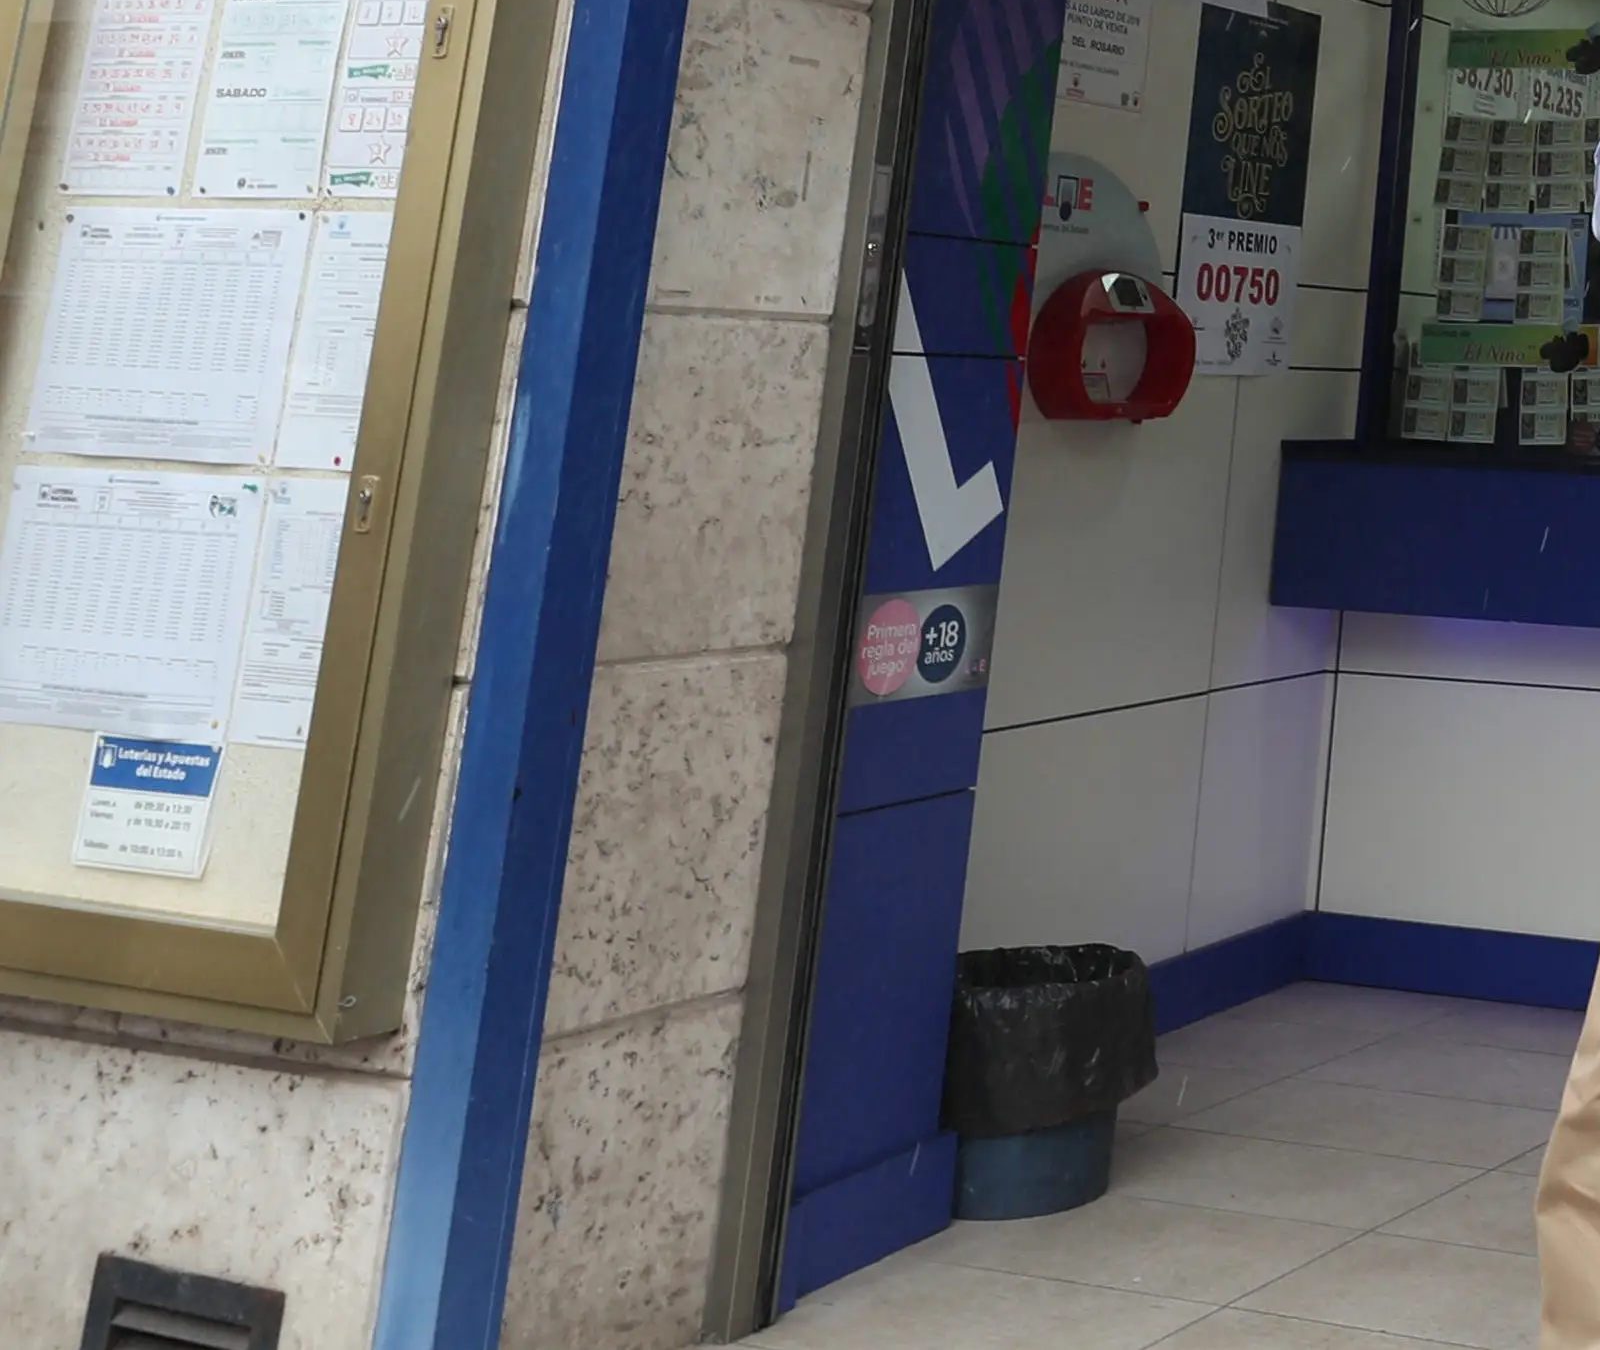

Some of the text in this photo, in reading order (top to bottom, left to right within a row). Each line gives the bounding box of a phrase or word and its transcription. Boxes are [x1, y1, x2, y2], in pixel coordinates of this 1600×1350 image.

[1228, 230, 1278, 255] PREMIO
[1196, 262, 1280, 307] 00750
[925, 620, 960, 648] +18
[924, 647, 955, 665] años
